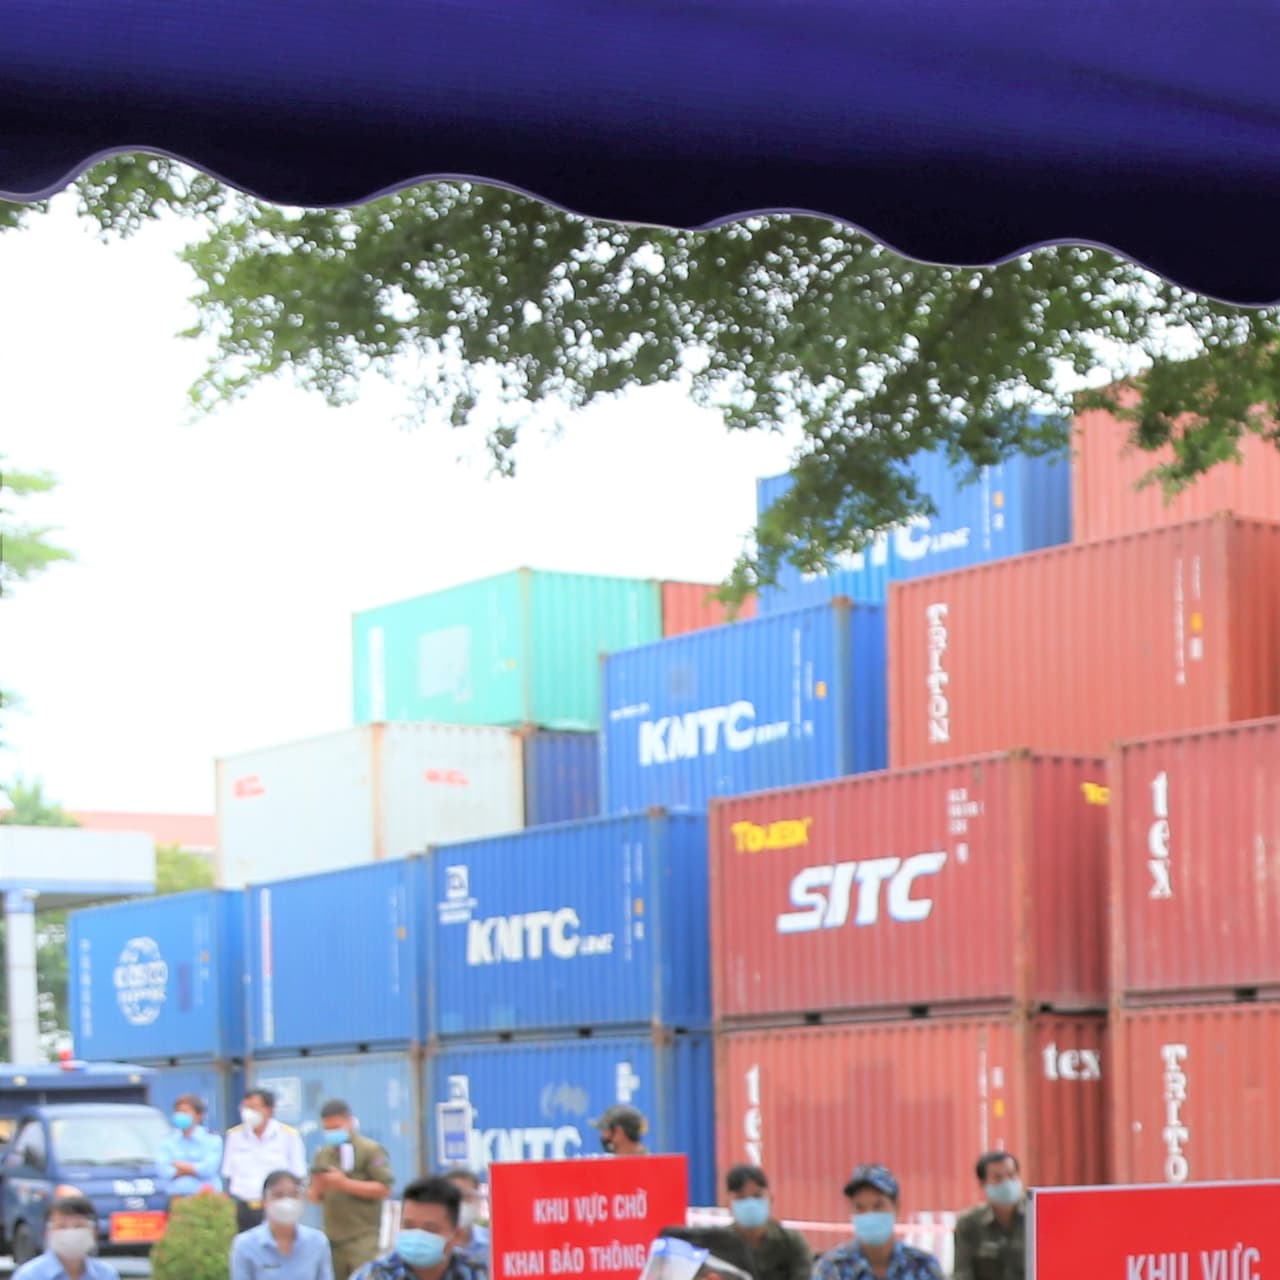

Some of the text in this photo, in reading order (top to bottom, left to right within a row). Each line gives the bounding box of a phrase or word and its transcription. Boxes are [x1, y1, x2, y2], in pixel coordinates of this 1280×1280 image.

[926, 603, 950, 743] TRITON
[776, 851, 948, 934] SITC
[1042, 1043, 1101, 1081] tex
[1161, 1044, 1190, 1182] TRITO
[533, 1187, 648, 1226] KHU VỰC CHỜ
[503, 1239, 647, 1277] KHAI BÁO THÔNG
